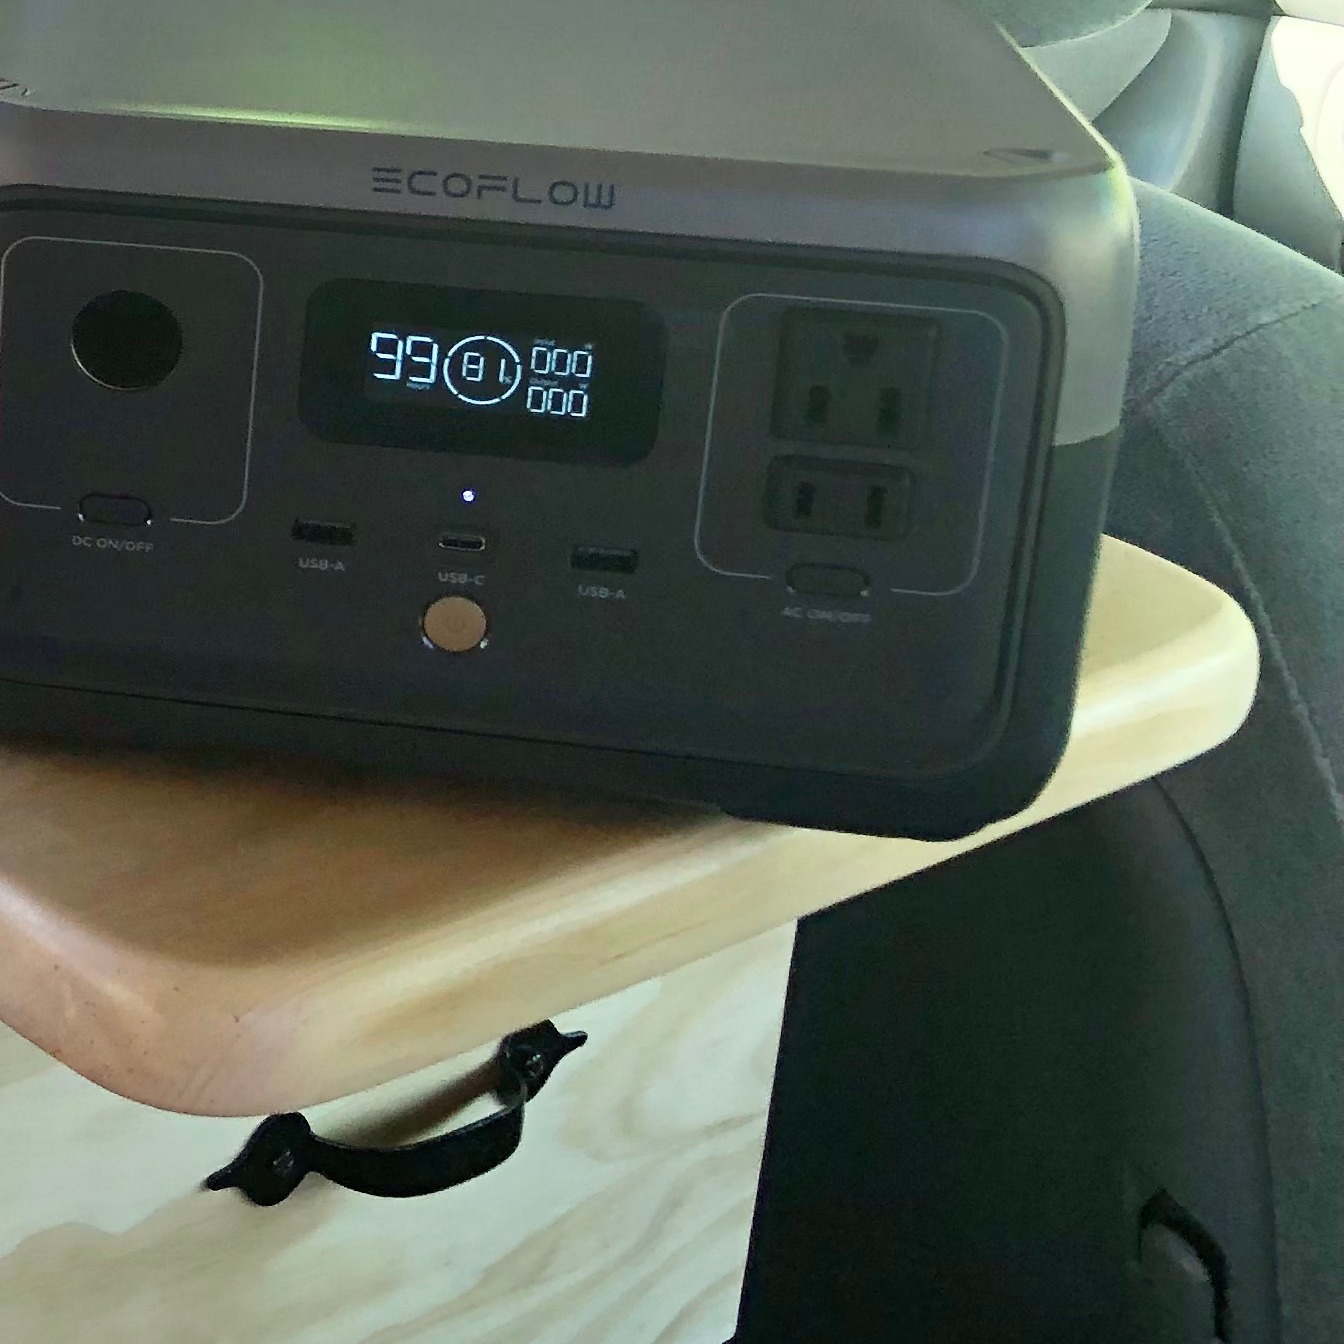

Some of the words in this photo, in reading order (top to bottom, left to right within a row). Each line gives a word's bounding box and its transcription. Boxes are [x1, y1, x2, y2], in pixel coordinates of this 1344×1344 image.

[372, 166, 615, 209] ECOFLOW
[371, 332, 438, 384] 99
[530, 346, 592, 378] 000
[526, 385, 588, 417] 000
[72, 535, 91, 547] DC
[97, 536, 154, 553] ON/OFF
[299, 558, 345, 572] USB-A
[438, 571, 485, 586] USB-C
[578, 585, 626, 600] USB-A
